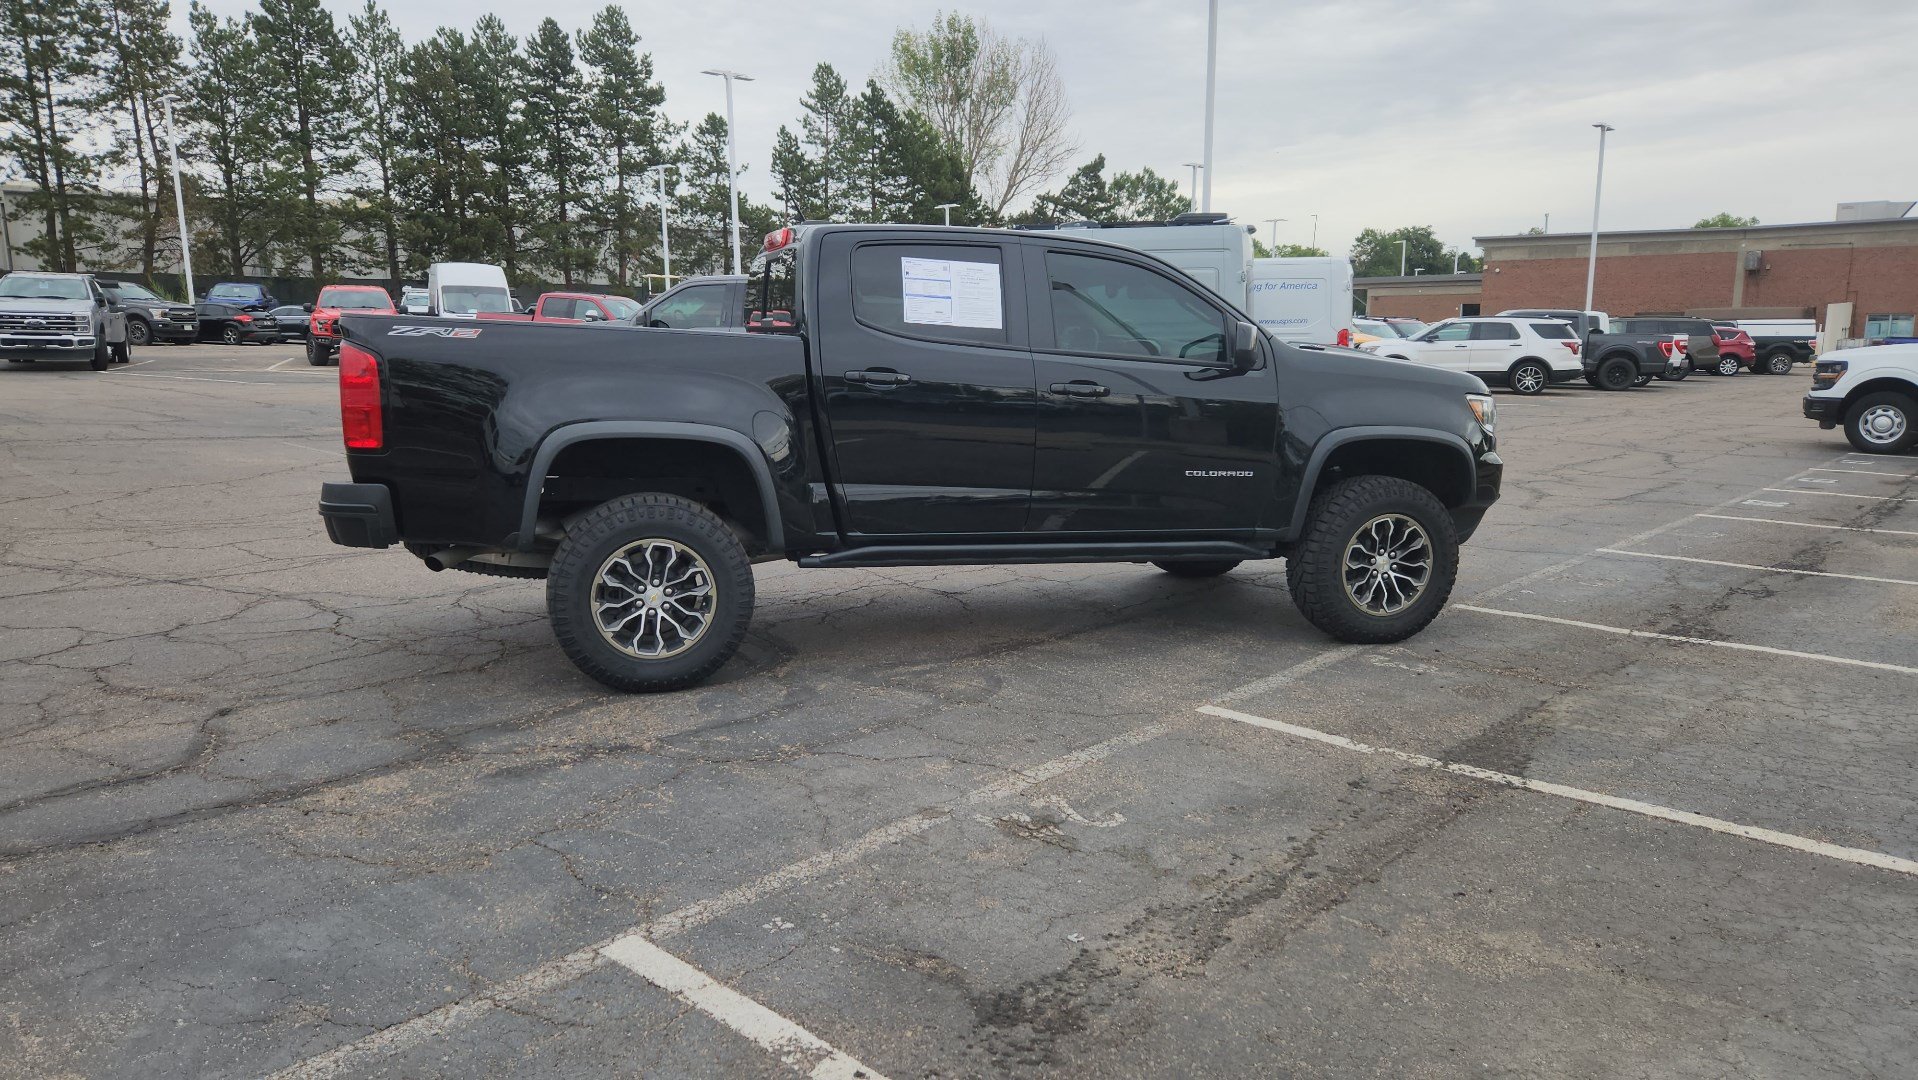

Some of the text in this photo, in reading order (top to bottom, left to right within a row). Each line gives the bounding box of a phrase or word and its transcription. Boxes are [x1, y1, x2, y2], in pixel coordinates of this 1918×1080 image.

[1264, 282, 1278, 290] for
[1279, 282, 1318, 290] America
[387, 325, 483, 339] ZR2
